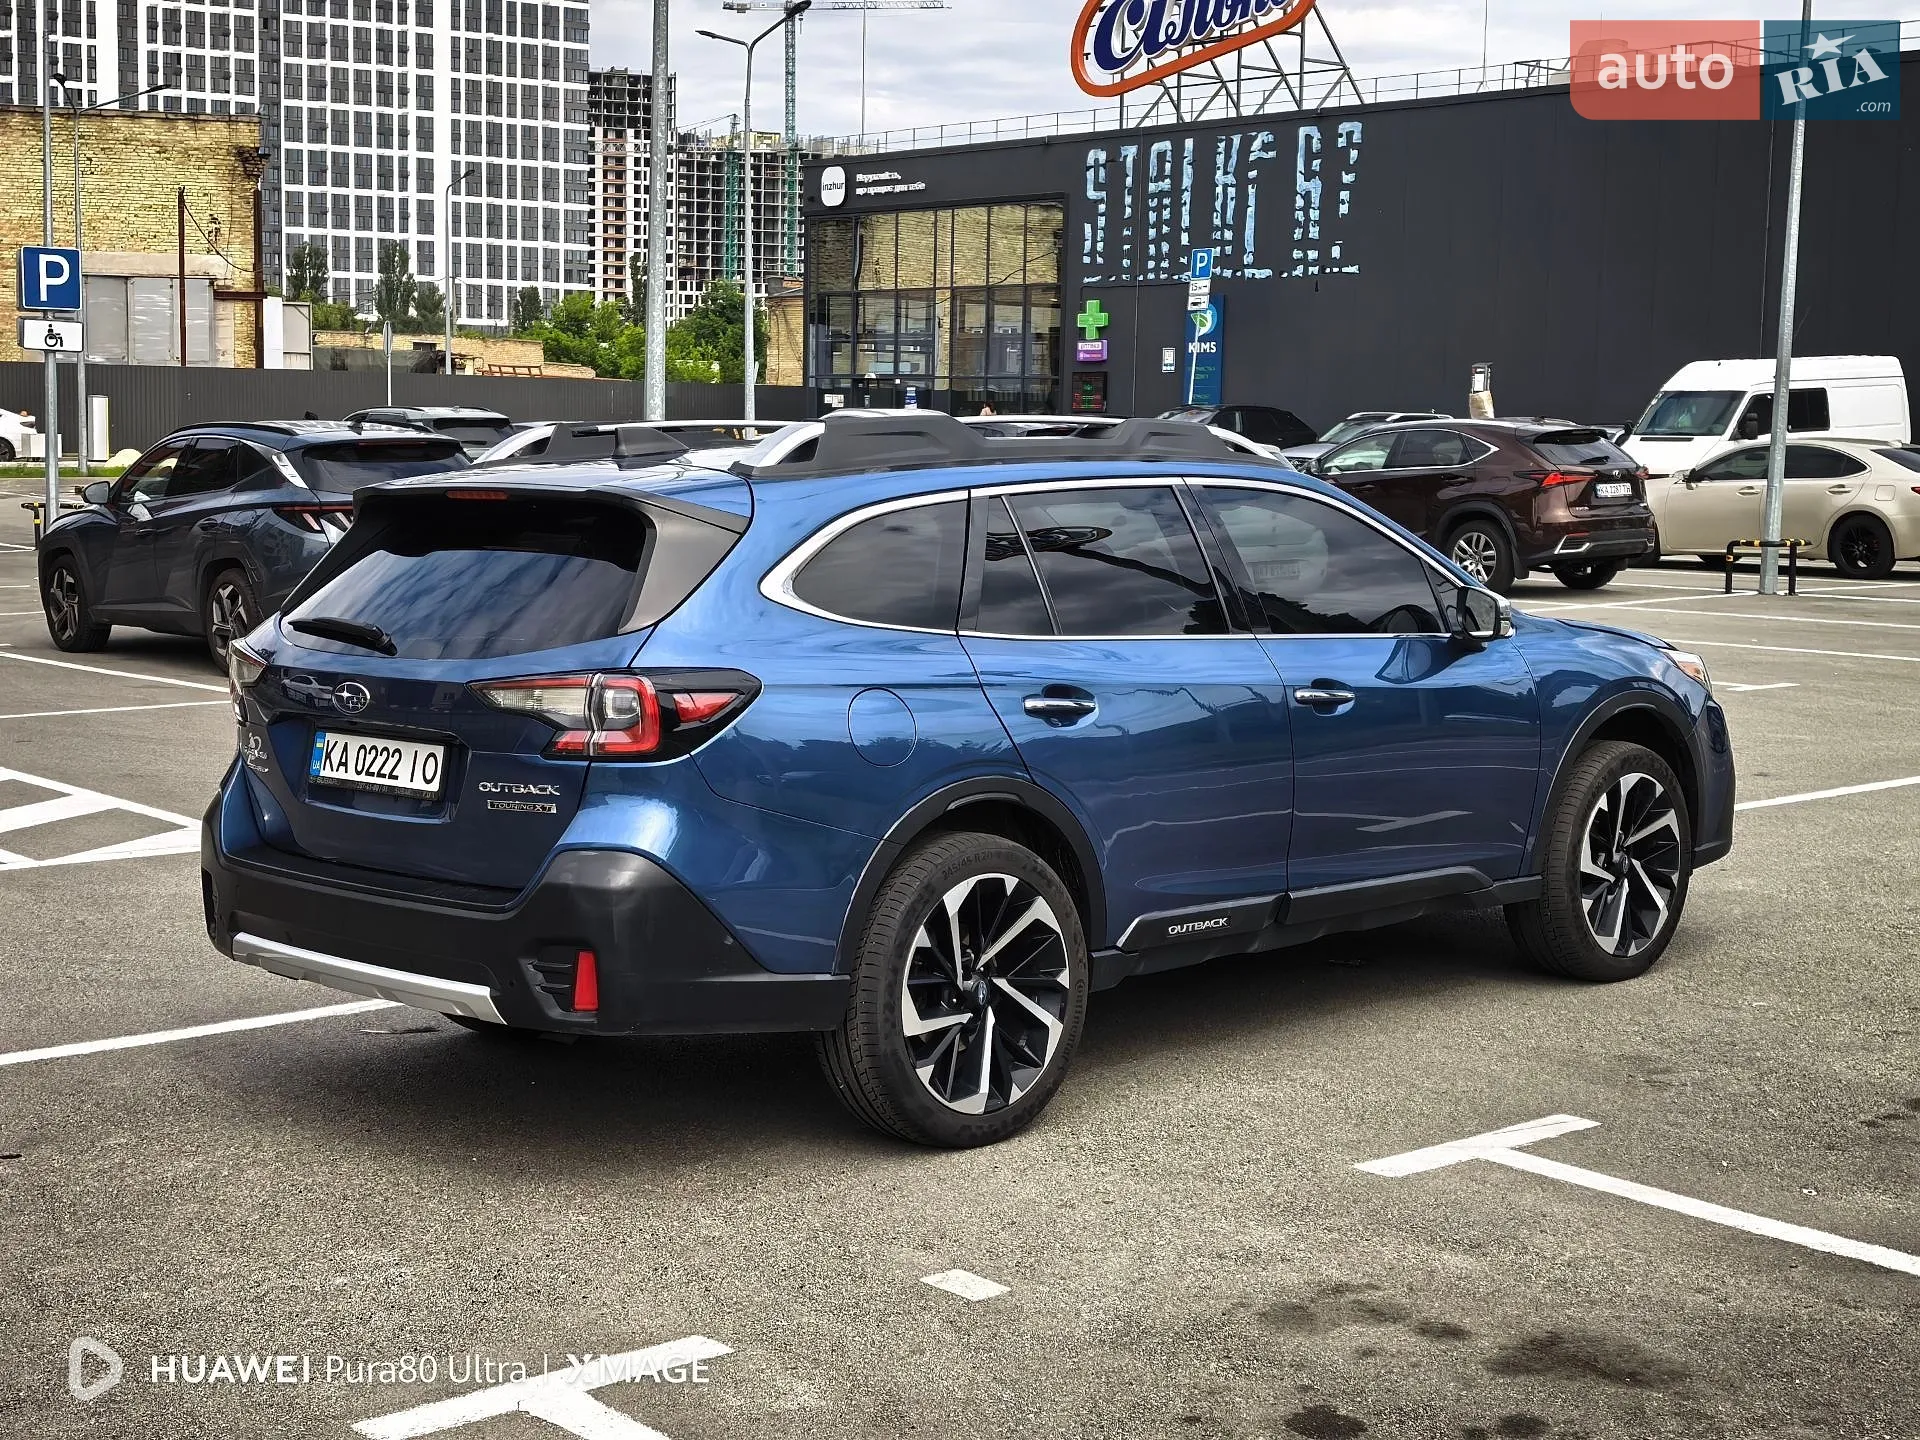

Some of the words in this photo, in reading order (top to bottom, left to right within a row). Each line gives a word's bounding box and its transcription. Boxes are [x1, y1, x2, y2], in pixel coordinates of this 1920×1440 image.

[1093, 0, 1288, 71] Сіль
[822, 181, 845, 192] inzhur
[1196, 252, 1208, 276] P
[39, 254, 70, 301] P
[1188, 342, 1217, 353] KIMS
[323, 739, 349, 774] KA
[354, 744, 403, 780] 0222
[410, 750, 439, 785] IO
[478, 781, 560, 796] OUTBACK
[1168, 917, 1228, 935] OUTBACK
